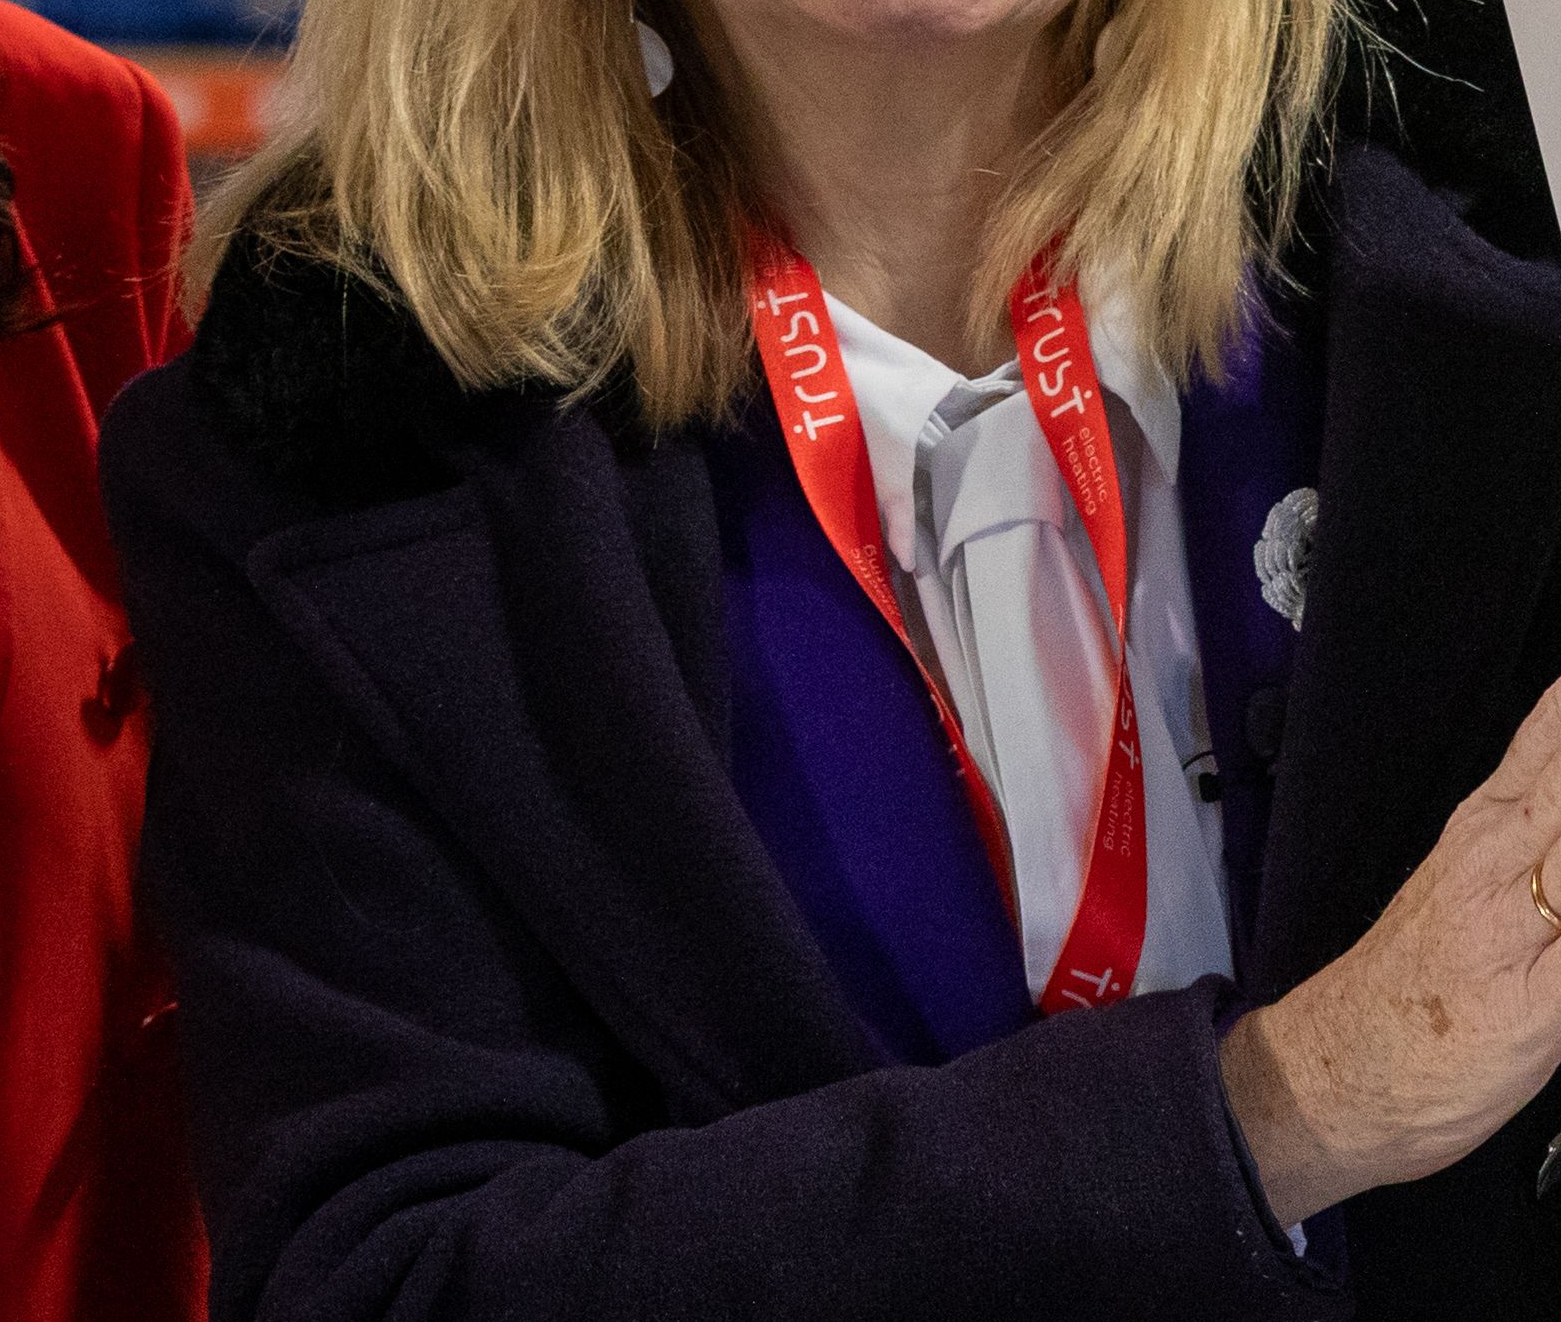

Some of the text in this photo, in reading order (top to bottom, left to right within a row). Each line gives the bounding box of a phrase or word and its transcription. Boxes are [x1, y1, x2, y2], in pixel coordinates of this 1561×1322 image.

[757, 287, 845, 442] trust
[1023, 284, 1093, 419] trust
[1062, 435, 1098, 517] heating
[1079, 426, 1108, 504] electric
